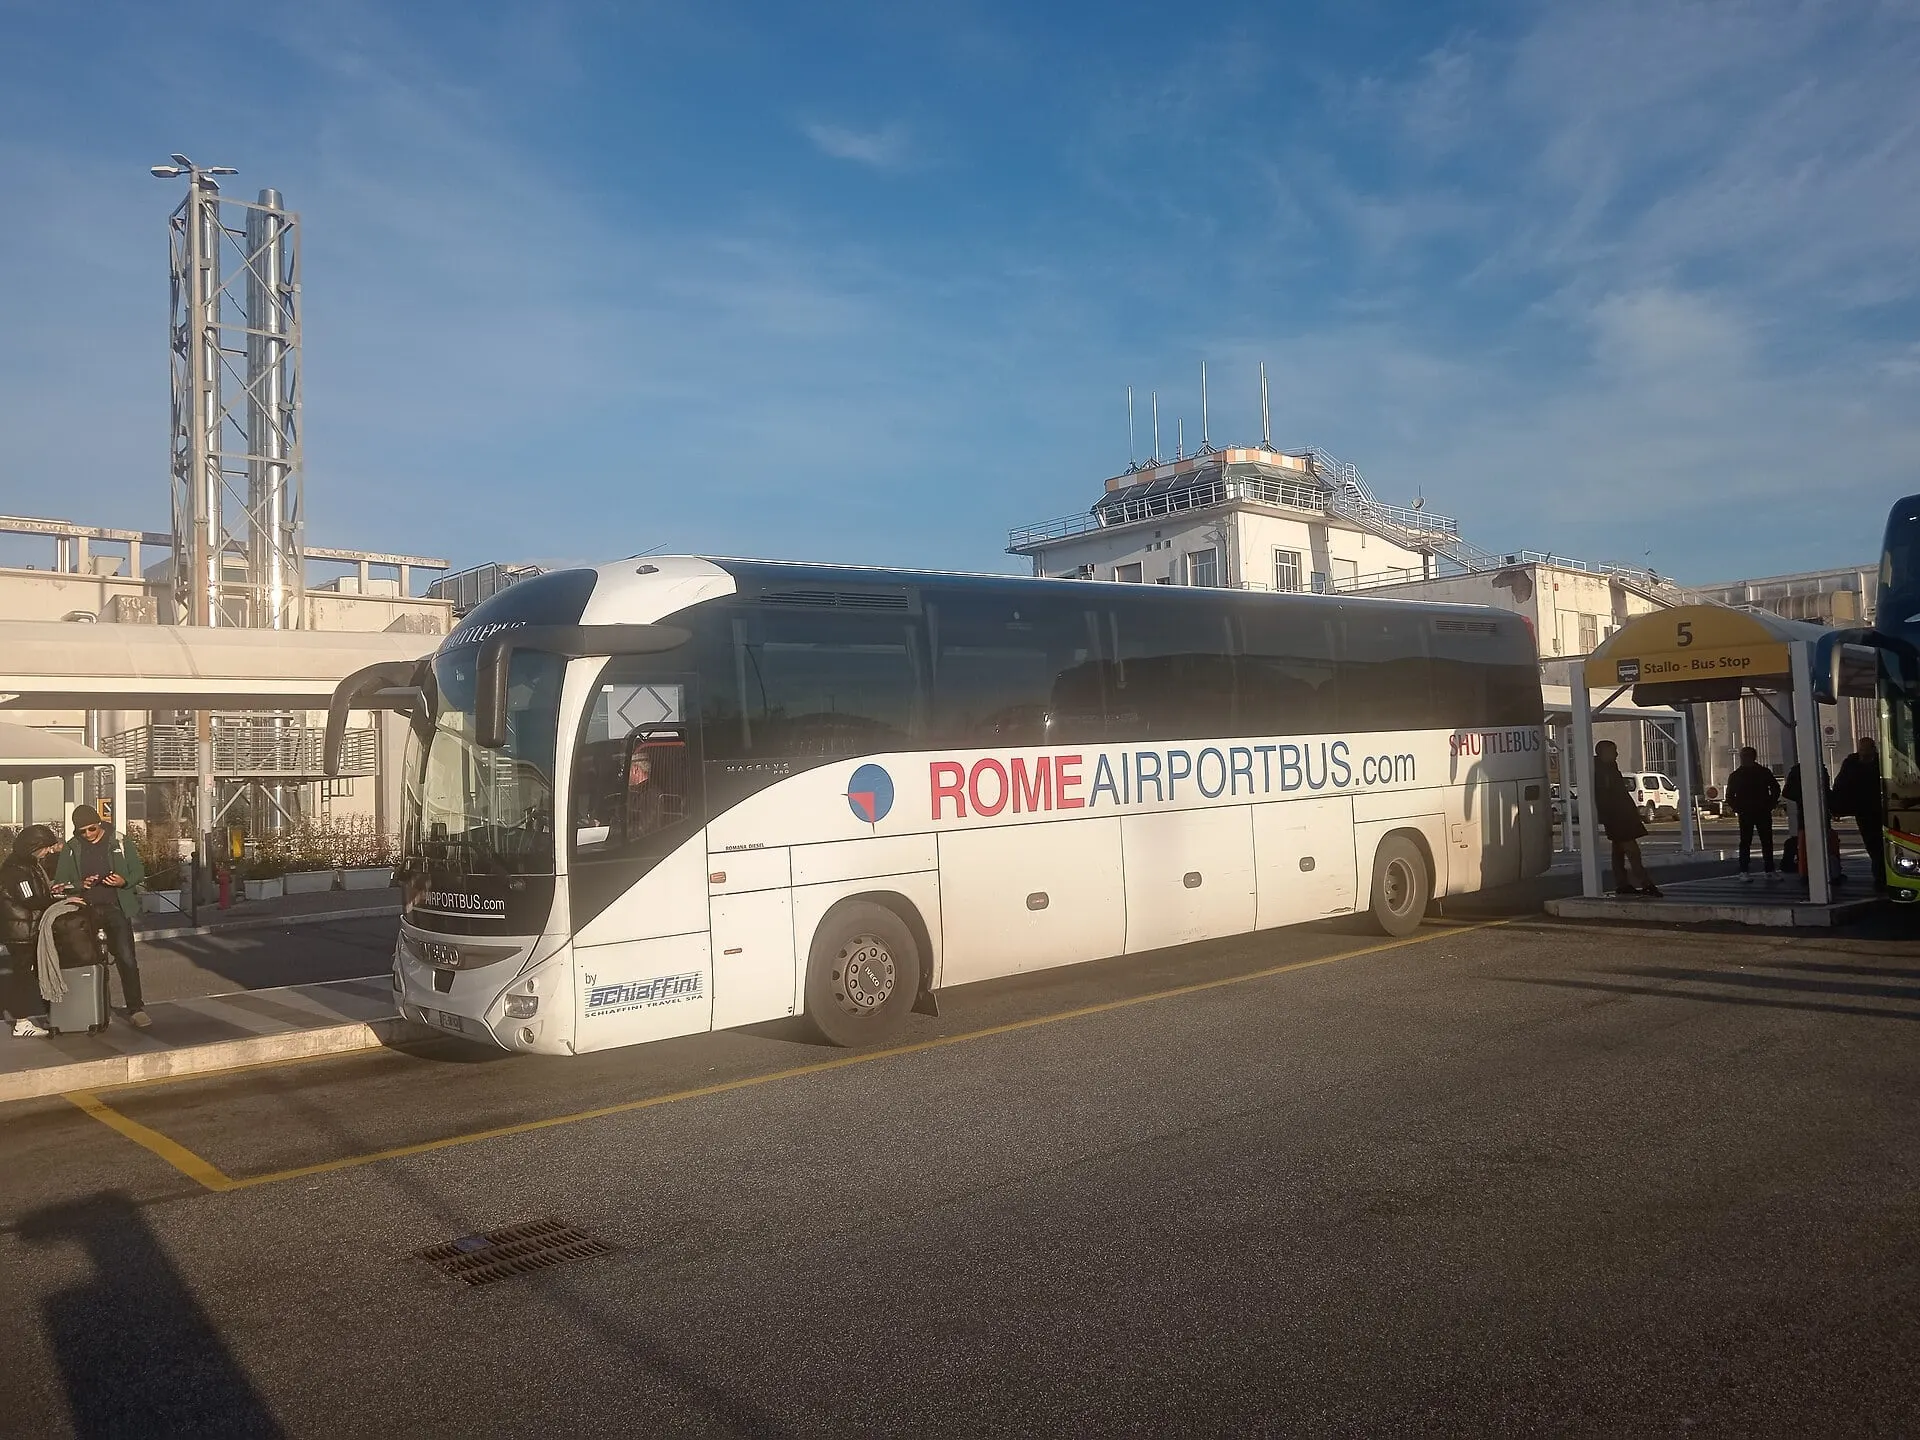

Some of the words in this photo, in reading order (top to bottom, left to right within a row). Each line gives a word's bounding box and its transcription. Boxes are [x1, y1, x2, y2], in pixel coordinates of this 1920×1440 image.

[1676, 621, 1693, 647] 5
[1643, 661, 1681, 674] Stallo
[1691, 659, 1716, 670] Bus
[1719, 656, 1751, 668] Stop
[1448, 730, 1541, 757] SHUTTLEBUS
[585, 972, 597, 986] by
[864, 966, 880, 987] IVECO
[584, 1004, 643, 1019] SCHIAFFINI
[647, 998, 681, 1009] TRAVEL
[685, 994, 703, 1002] SPA
